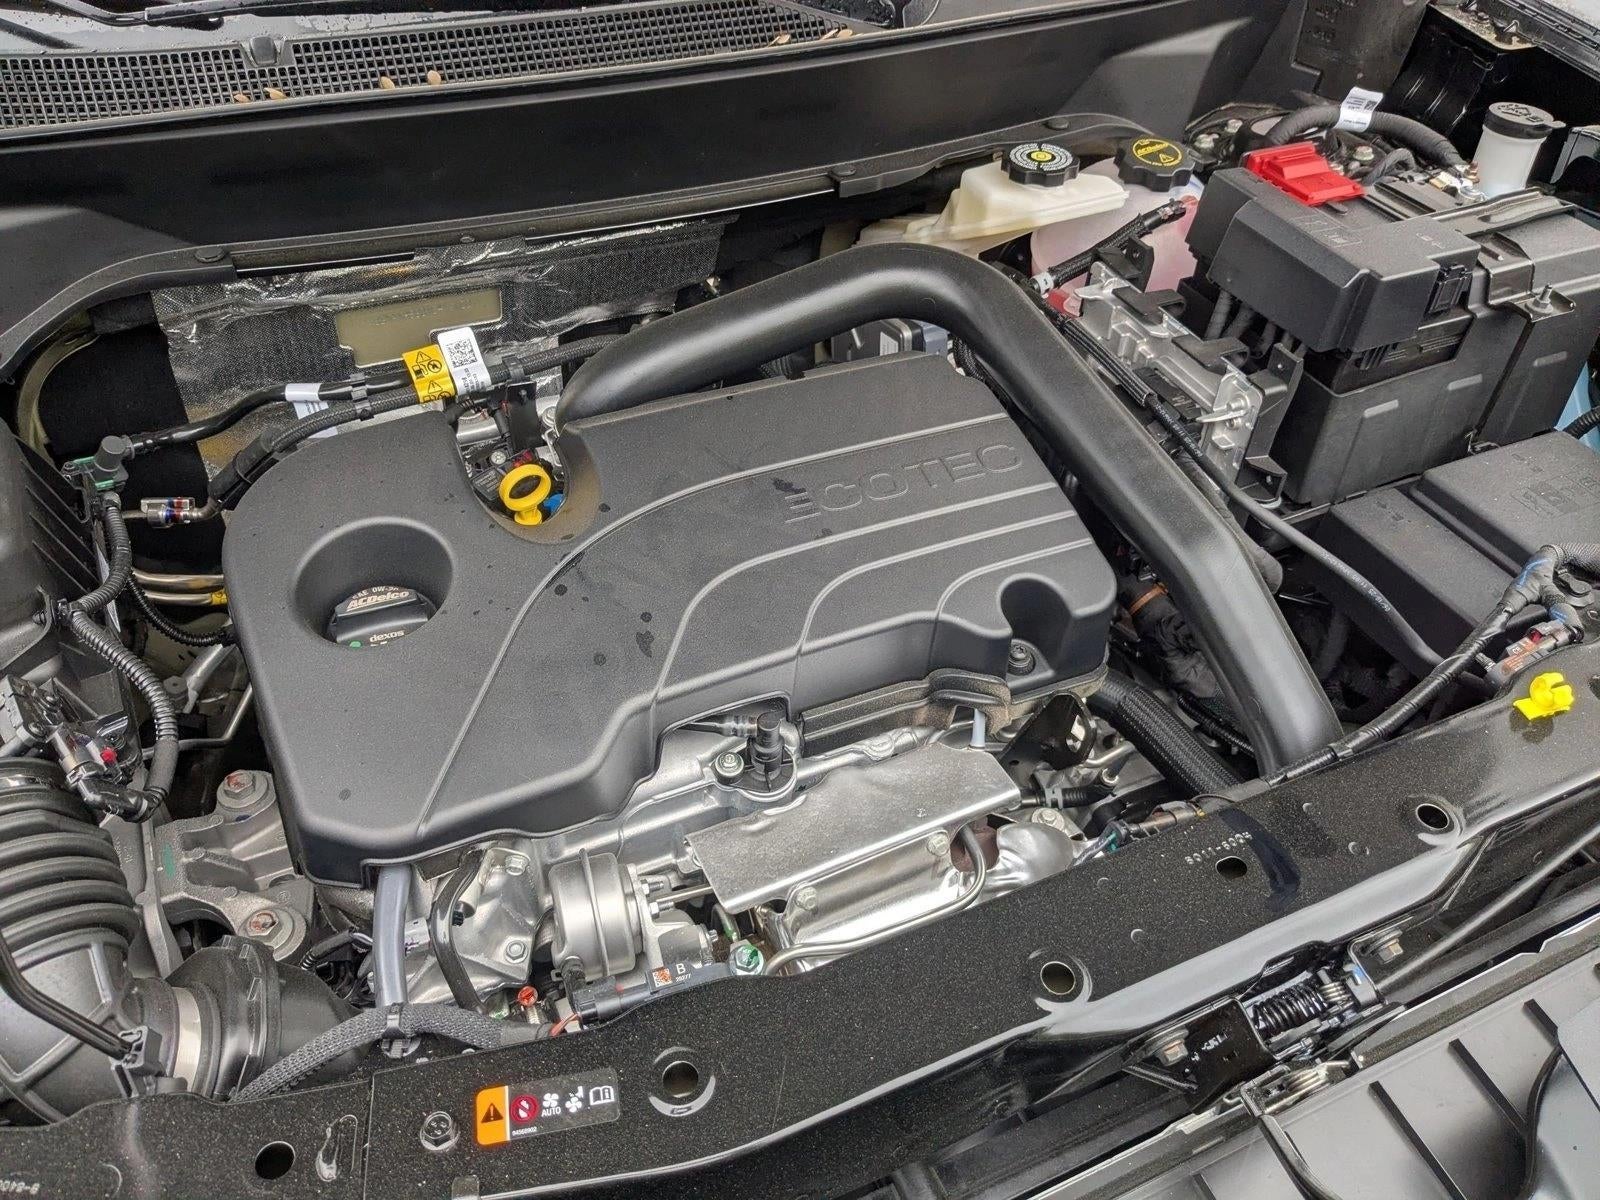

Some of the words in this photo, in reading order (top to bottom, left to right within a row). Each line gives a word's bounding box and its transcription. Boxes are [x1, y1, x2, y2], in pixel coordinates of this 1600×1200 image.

[783, 444, 1023, 524] ECOTEC
[347, 592, 409, 609] ACDelco
[370, 630, 405, 642] dexos
[676, 963, 686, 975] B
[541, 1106, 562, 1117] AUTO
